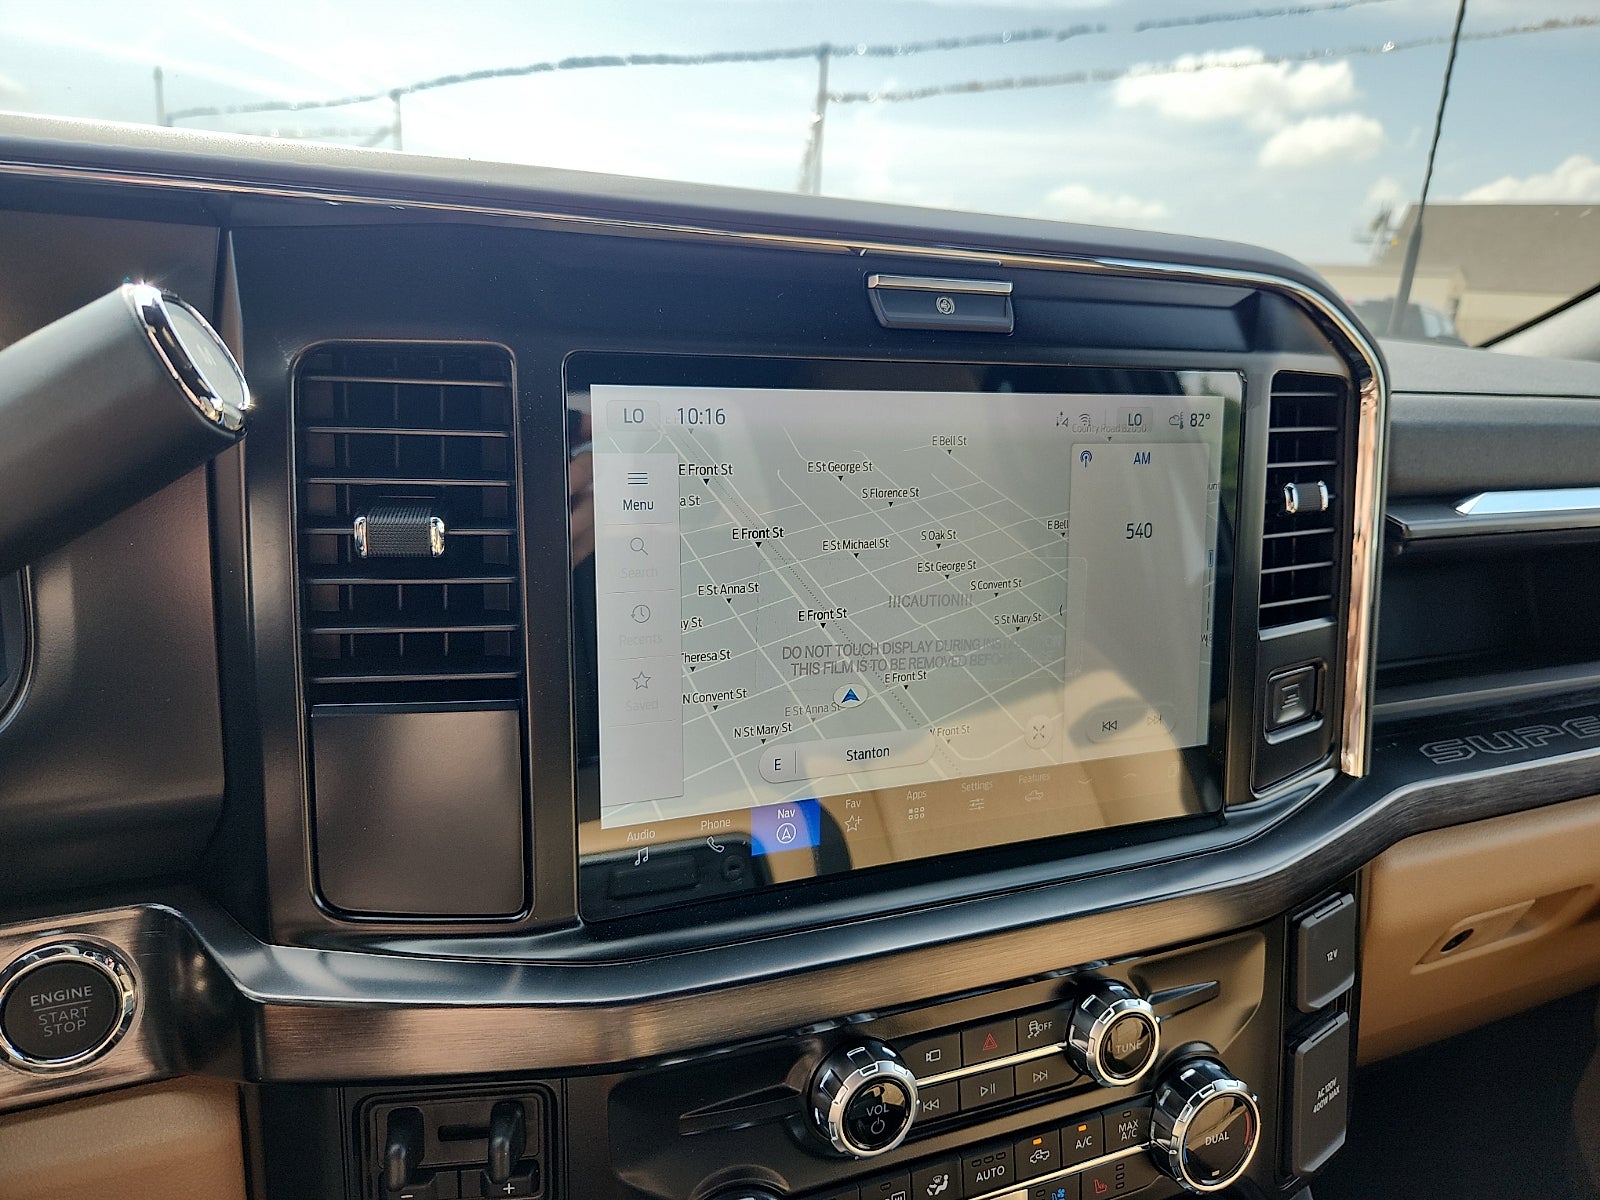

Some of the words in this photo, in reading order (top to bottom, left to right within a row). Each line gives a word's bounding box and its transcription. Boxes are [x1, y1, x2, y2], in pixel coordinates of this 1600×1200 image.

[623, 408, 645, 424] LO
[677, 407, 726, 426] 10:16
[1127, 413, 1142, 427] LO
[932, 436, 938, 446] E
[939, 435, 954, 446] Bell
[956, 435, 967, 446] St
[1133, 452, 1151, 465] AM
[678, 464, 686, 476] E
[687, 464, 719, 476] Front
[720, 463, 733, 475] St
[807, 462, 813, 473] E
[815, 462, 826, 472] St
[827, 461, 860, 474] George
[861, 461, 873, 472] St
[861, 489, 868, 499] S
[869, 487, 907, 499] Florence
[909, 487, 919, 498] St
[623, 499, 654, 511] Menu
[688, 495, 700, 506] St
[1047, 520, 1053, 530] E
[1054, 519, 1069, 529] Bell
[1125, 522, 1152, 540] 540
[731, 528, 739, 540] E
[740, 528, 771, 539] Front
[772, 527, 784, 538] St
[921, 531, 927, 541] S
[928, 530, 945, 540] Oak
[946, 529, 957, 540] St
[822, 541, 829, 551] E
[830, 540, 841, 550] St
[842, 539, 877, 550] Michael
[879, 539, 889, 549] St
[917, 562, 923, 572] E
[924, 562, 934, 572] St
[935, 560, 965, 573] George
[966, 559, 977, 570] St
[698, 586, 705, 596] E
[706, 585, 718, 595] St
[719, 584, 747, 595] Anna
[748, 583, 759, 593] St
[970, 580, 976, 591] S
[977, 579, 1011, 590] Convent
[1012, 578, 1022, 588] St
[798, 610, 805, 622] E
[806, 609, 835, 621] Front
[836, 608, 847, 619] St
[994, 615, 1000, 625] S
[1001, 614, 1010, 625] St
[1011, 614, 1031, 626] Mary
[1032, 612, 1042, 623] St
[691, 617, 703, 628] St
[719, 650, 731, 660] St
[782, 645, 803, 660] DO
[805, 644, 833, 659] NOT
[835, 642, 879, 658] TOUCH
[882, 640, 933, 656] DISPLAY
[935, 638, 981, 653] DURING
[791, 661, 820, 677] THIS
[823, 660, 854, 676] FILM
[856, 659, 868, 673] IS
[869, 658, 888, 672] TO
[890, 657, 906, 671] BE
[909, 654, 967, 670] REMOVED
[885, 673, 891, 683] E
[892, 672, 916, 683] Front
[917, 671, 927, 681] St
[682, 694, 691, 705] N
[692, 690, 734, 703] Convent
[736, 688, 748, 699] St
[785, 707, 791, 717] E
[792, 706, 803, 716] St
[805, 704, 829, 715] Anna
[831, 702, 842, 713] St
[734, 727, 741, 738] N
[742, 726, 754, 737] St
[756, 724, 780, 738] Mary
[781, 722, 792, 733] St
[937, 725, 960, 737] Front
[961, 724, 971, 735] St
[846, 747, 890, 762] Stanton
[774, 758, 782, 772] E
[961, 779, 993, 793] Settings
[906, 788, 927, 802] Apps
[845, 798, 861, 809] Fav
[777, 808, 796, 819] Nav
[700, 817, 731, 831] Phone
[627, 828, 656, 842] Audio
[1326, 948, 1338, 961] 12V
[30, 985, 93, 1007] ENGINE
[38, 1006, 89, 1026] START
[43, 1019, 87, 1038] STOP
[1037, 1020, 1053, 1031] OFF
[1115, 1040, 1142, 1053] TUNE
[866, 1103, 890, 1117] VOL
[1117, 1119, 1139, 1134] MAX
[1120, 1126, 1138, 1141] A/C
[1075, 1135, 1092, 1150] A/C
[1205, 1130, 1230, 1147] DUAL
[976, 1164, 1006, 1184] AUTO
